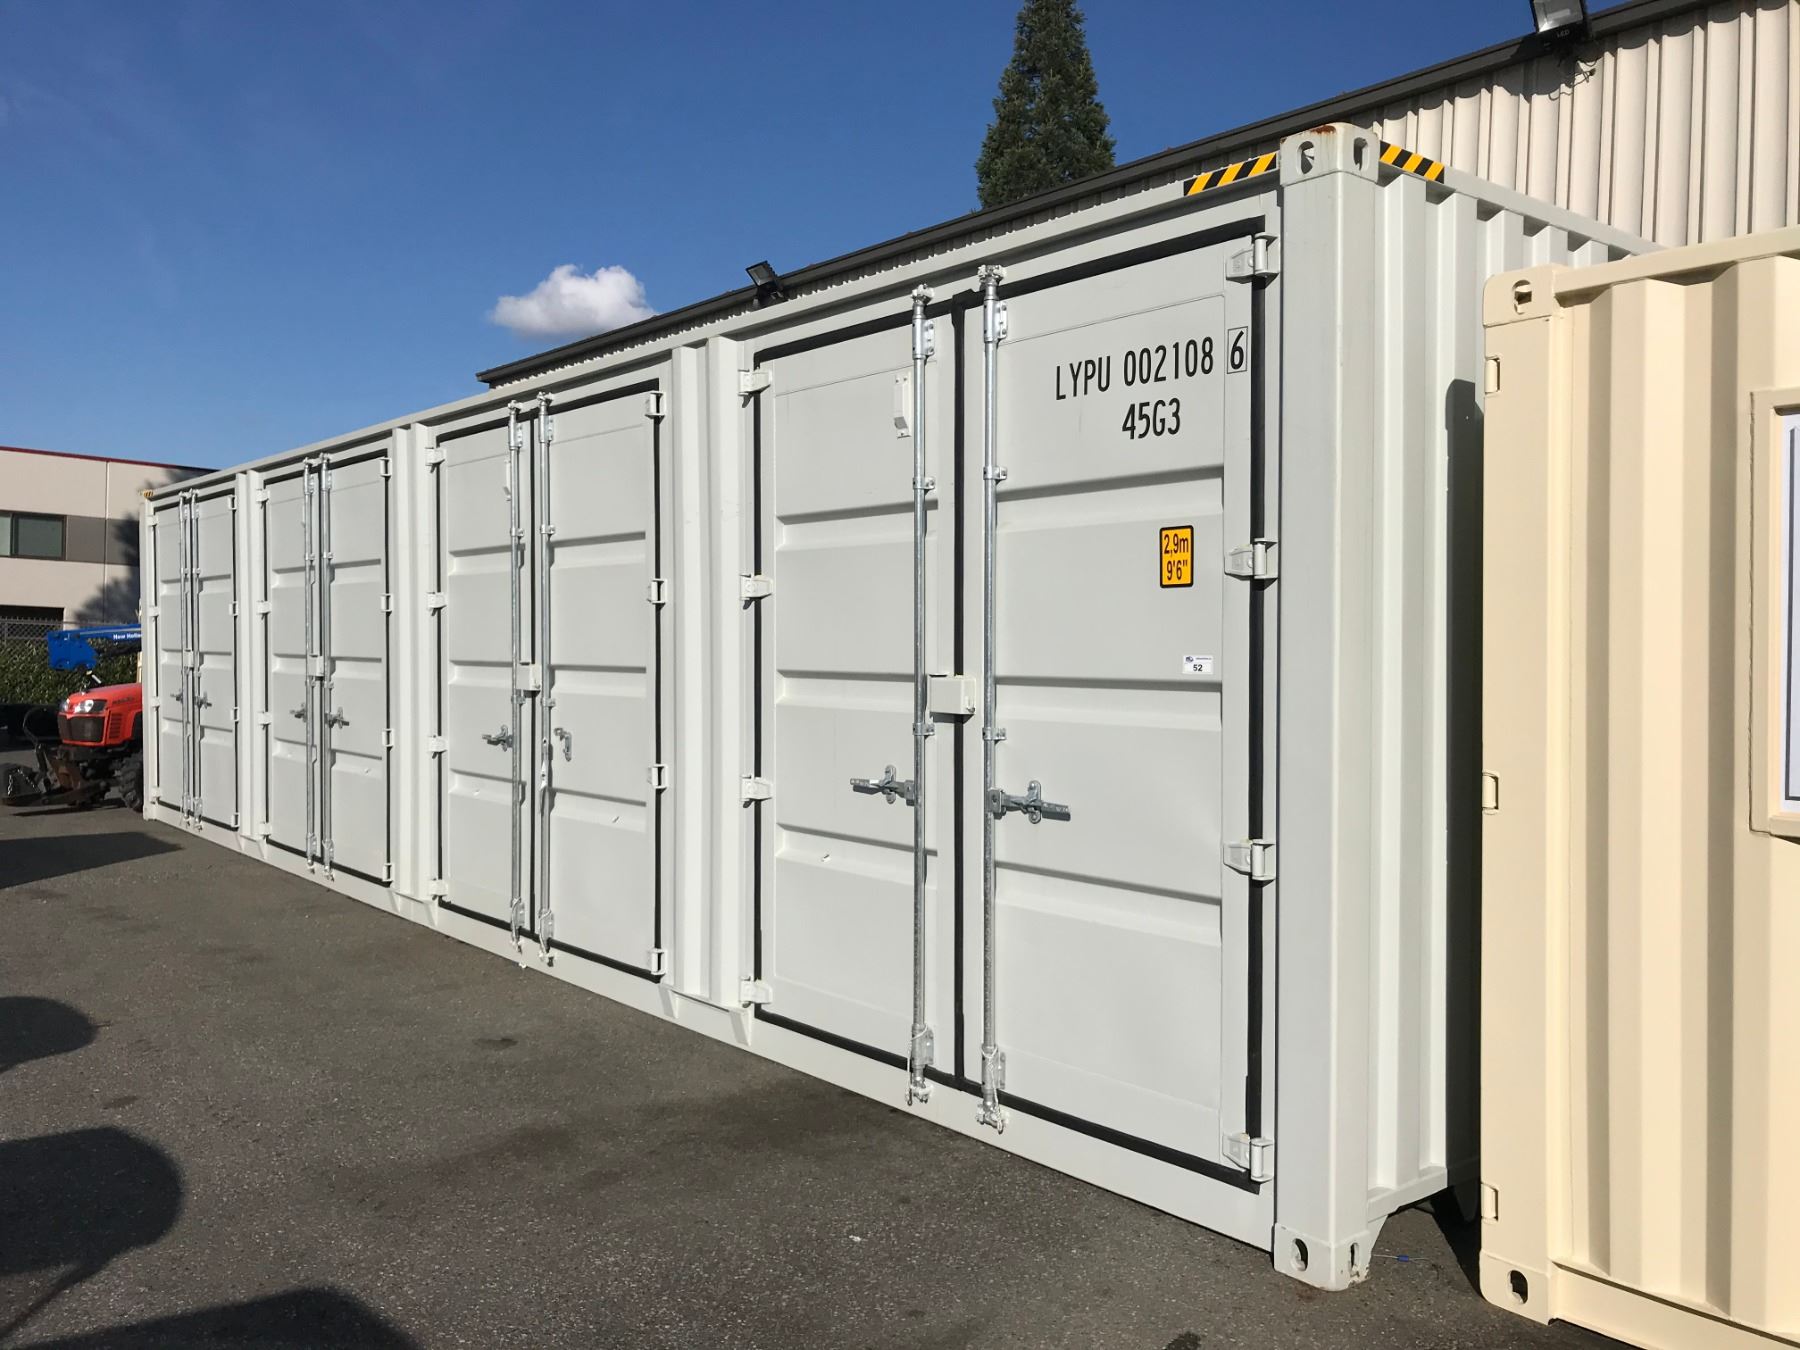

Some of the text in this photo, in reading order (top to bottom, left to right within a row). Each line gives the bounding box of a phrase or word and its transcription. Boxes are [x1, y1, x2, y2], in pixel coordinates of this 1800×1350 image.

[1056, 330, 1245, 401] LYPU 002108 6
[1121, 398, 1181, 440] 45G3
[1193, 663, 1203, 672] 52
